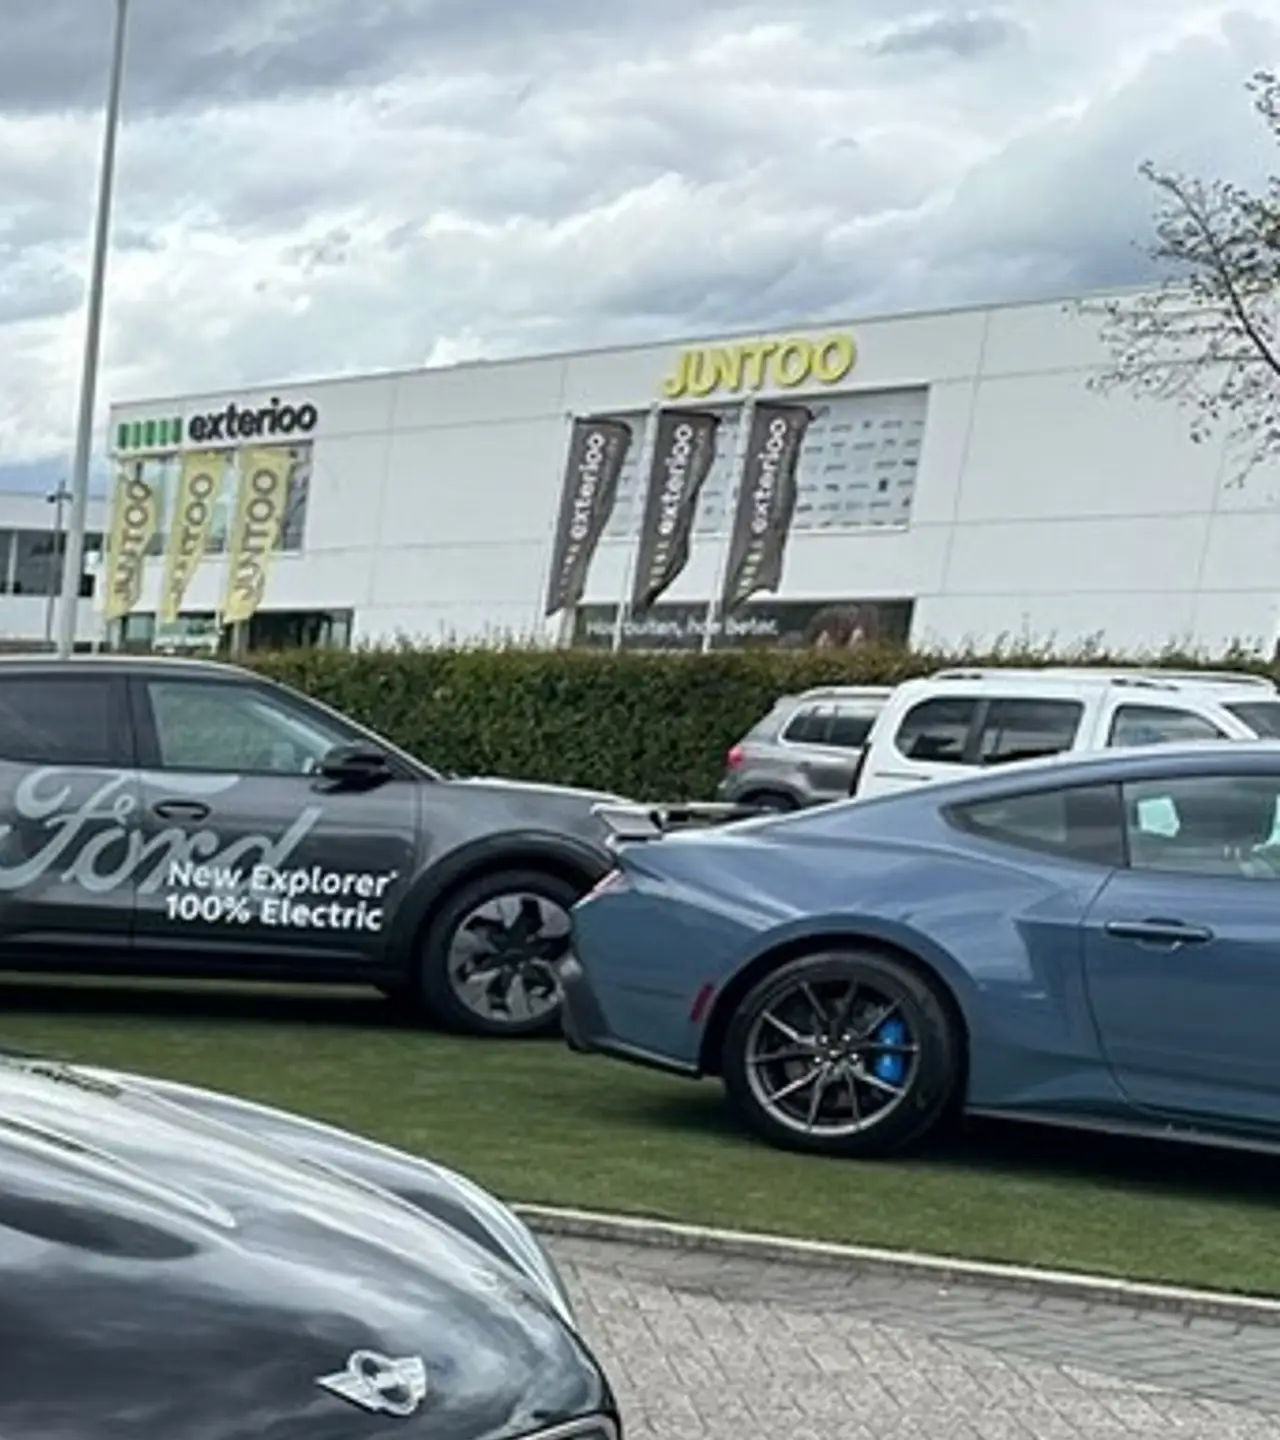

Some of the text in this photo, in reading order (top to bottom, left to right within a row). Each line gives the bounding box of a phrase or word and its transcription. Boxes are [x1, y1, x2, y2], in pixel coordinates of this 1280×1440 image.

[663, 332, 857, 398] JUNTOO
[188, 398, 318, 442] exterioo
[570, 433, 606, 540] exterioo
[658, 424, 693, 535] exterioo
[751, 418, 787, 534] exterioo
[168, 860, 244, 889] New
[164, 893, 384, 932] 100% Electric
